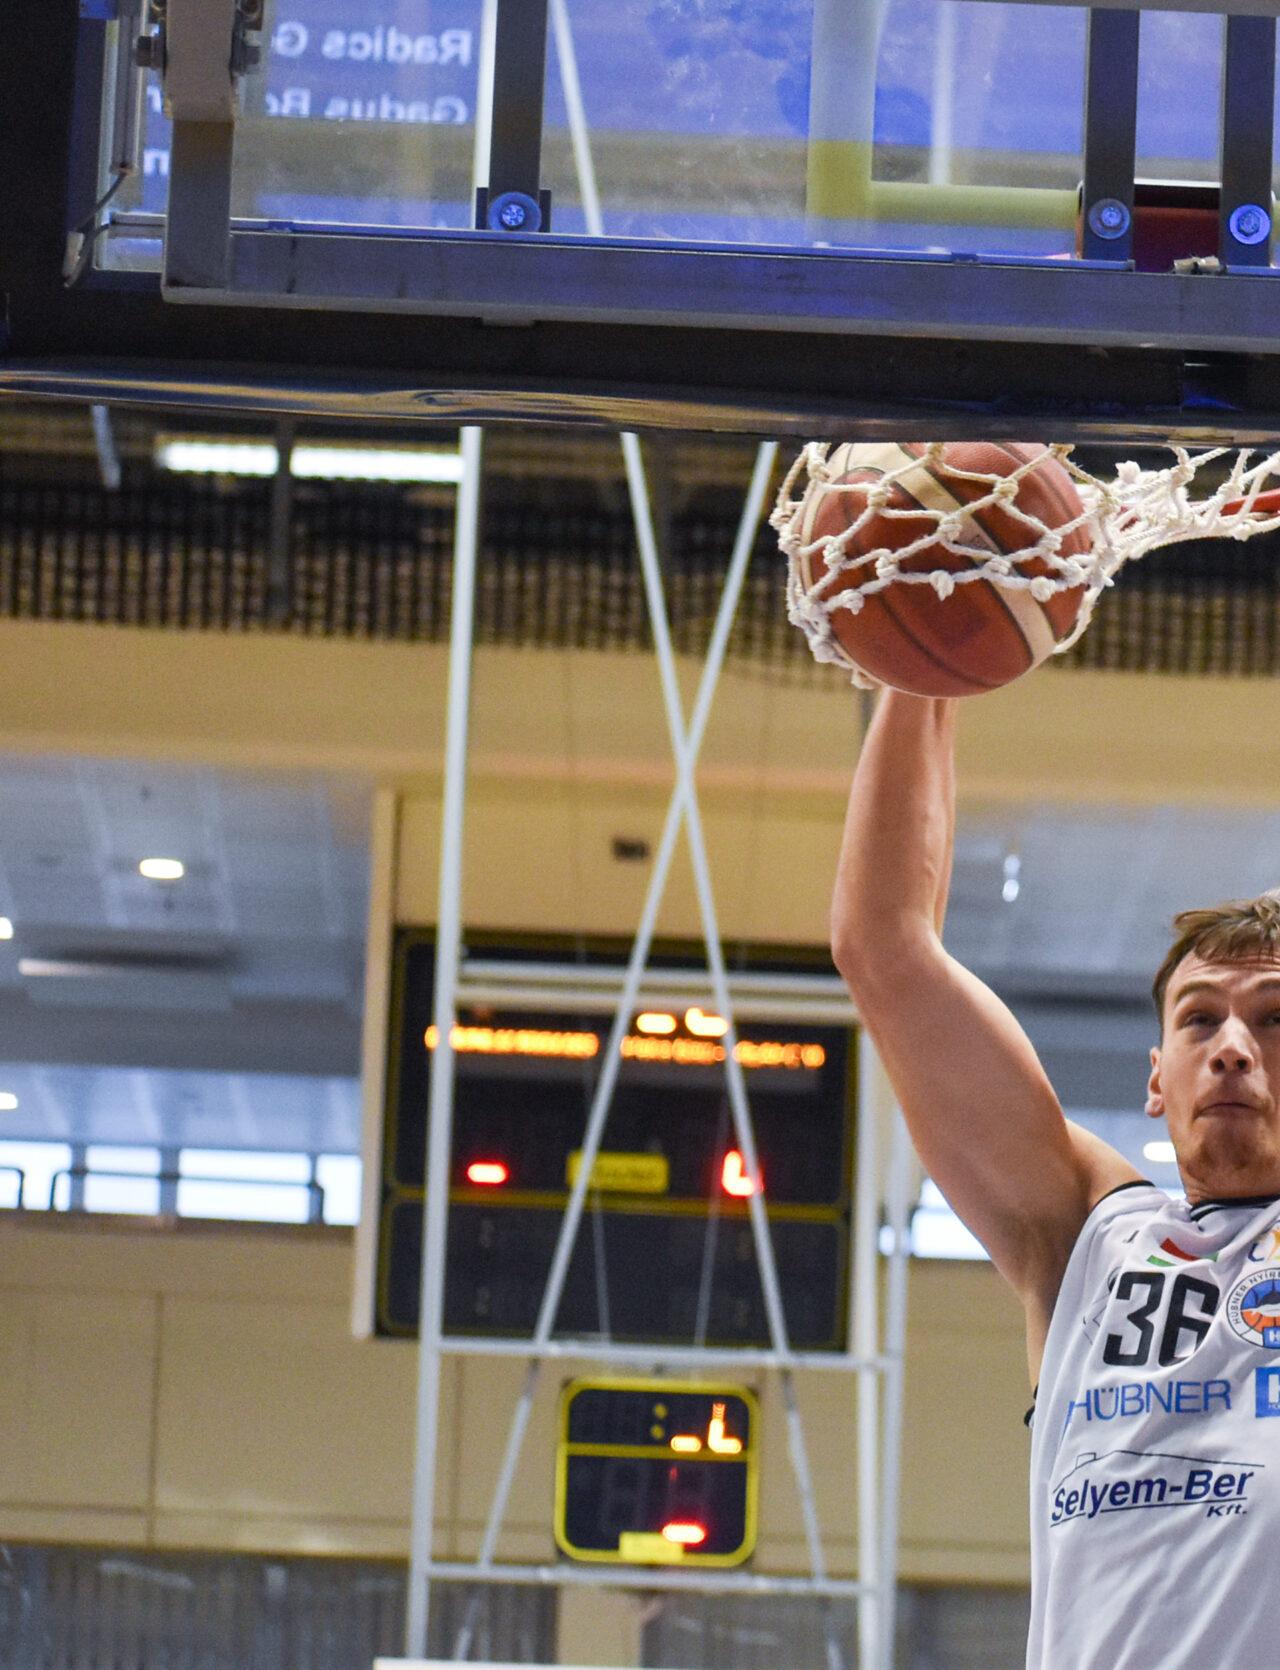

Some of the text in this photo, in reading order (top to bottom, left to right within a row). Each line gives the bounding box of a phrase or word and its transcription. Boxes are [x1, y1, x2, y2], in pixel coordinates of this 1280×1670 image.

[1103, 1271, 1220, 1367] 36
[1061, 1378, 1232, 1440] HÜBNER
[1051, 1468, 1255, 1520] Selyem-Ber
[1206, 1502, 1249, 1518] Kft.
